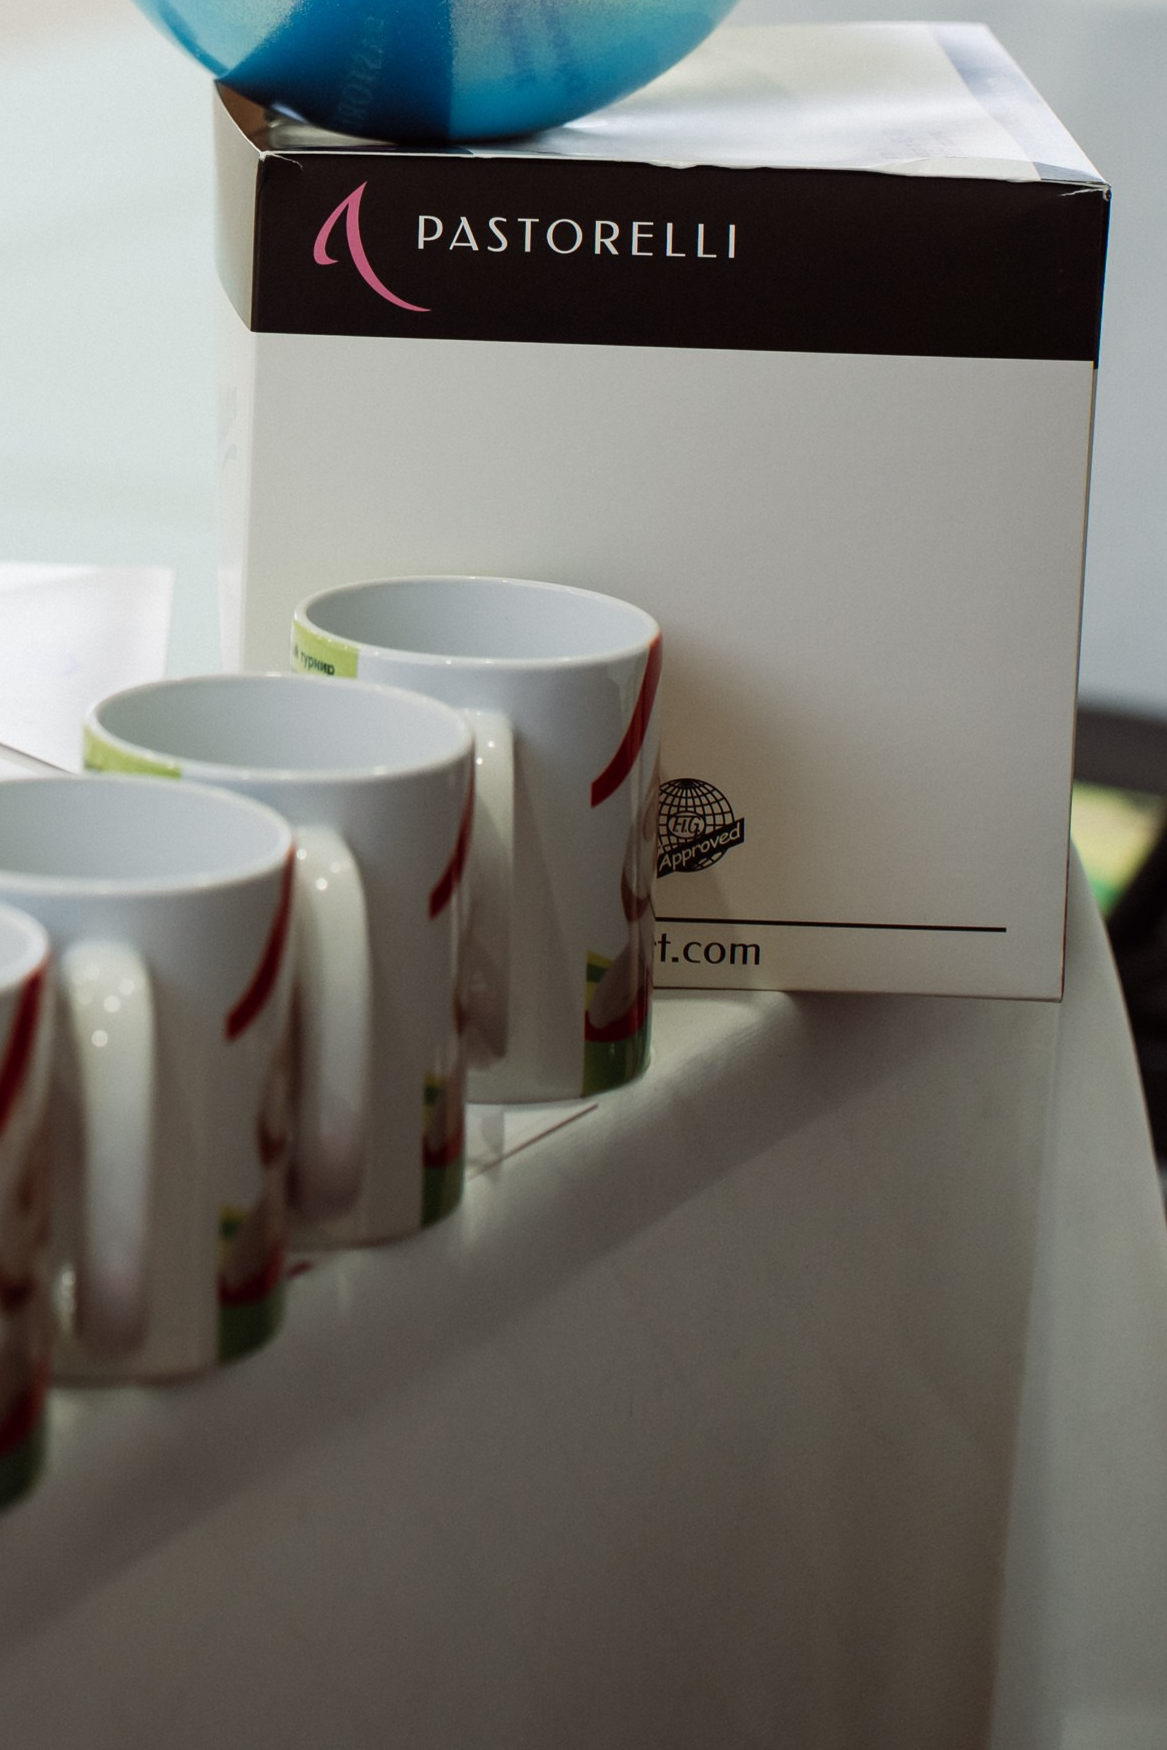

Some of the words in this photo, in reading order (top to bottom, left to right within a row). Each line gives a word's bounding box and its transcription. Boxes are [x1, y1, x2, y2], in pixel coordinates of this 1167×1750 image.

[417, 214, 736, 259] PASTORELLI
[658, 821, 741, 872] Approved
[654, 933, 761, 965] t.com
